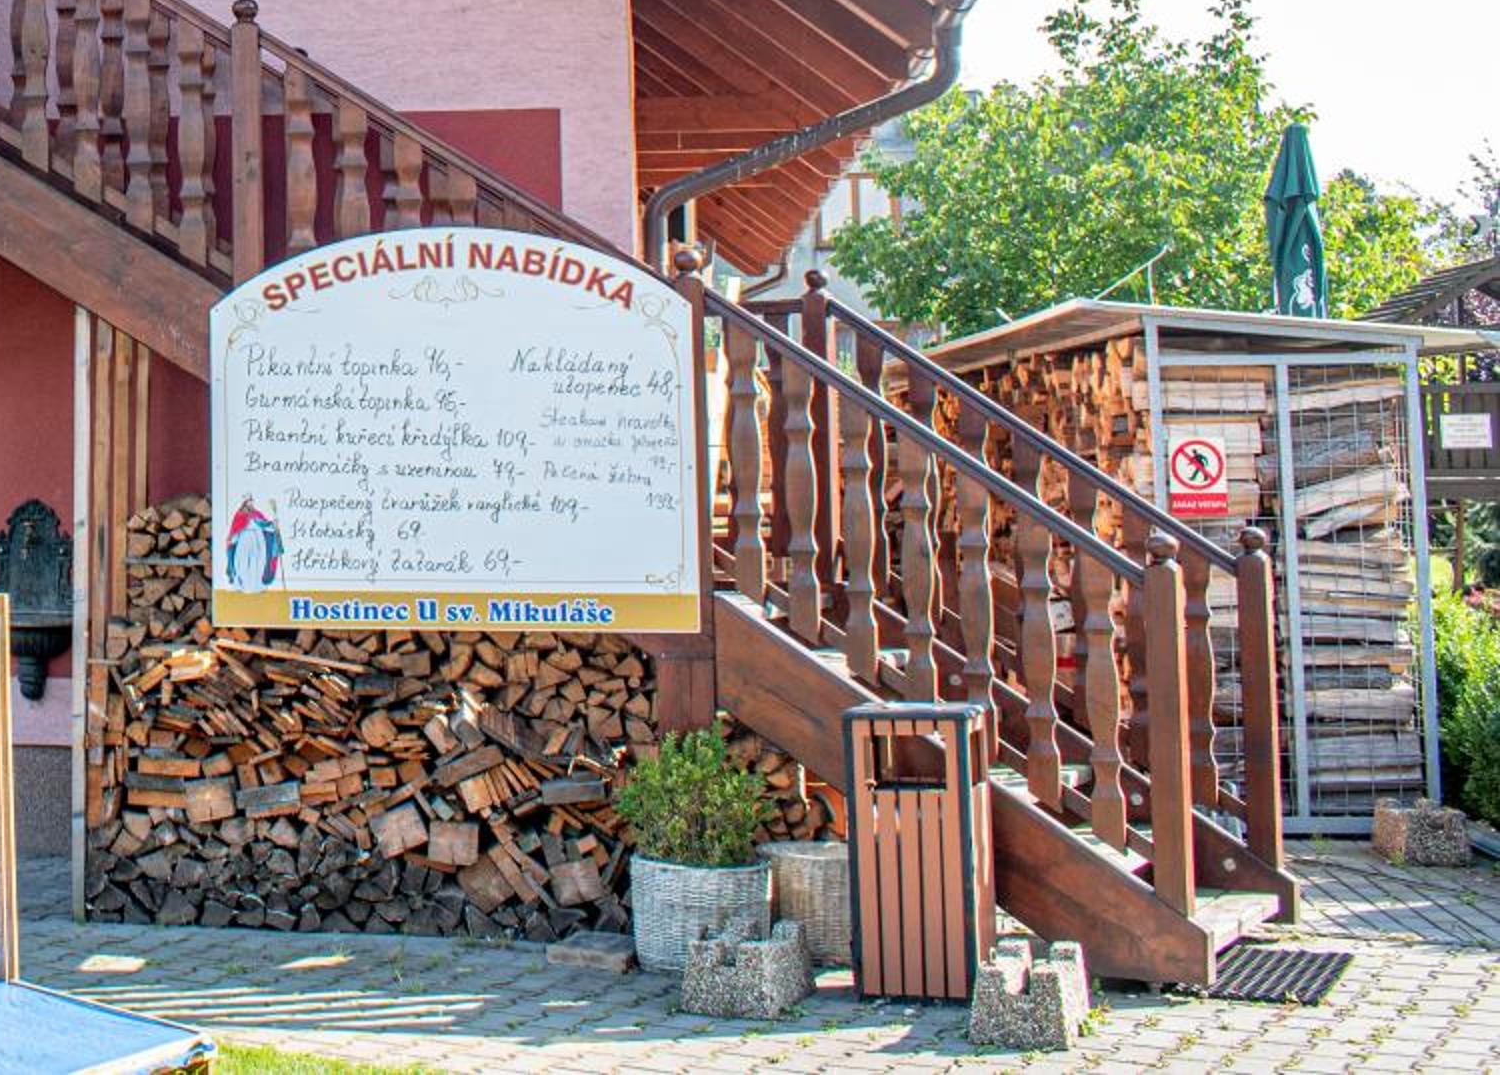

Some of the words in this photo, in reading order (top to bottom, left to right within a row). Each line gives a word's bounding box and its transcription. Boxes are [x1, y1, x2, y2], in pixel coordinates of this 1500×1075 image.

[261, 233, 455, 313] SPECIÁLNÍ
[467, 241, 636, 311] NABÍDKA
[340, 344, 419, 386] topinka
[358, 384, 430, 418] topinka
[376, 464, 389, 475] s
[292, 598, 410, 623] Hostinec
[417, 599, 438, 622] U
[446, 604, 480, 623] sv.
[488, 598, 614, 623] Mikuláše
